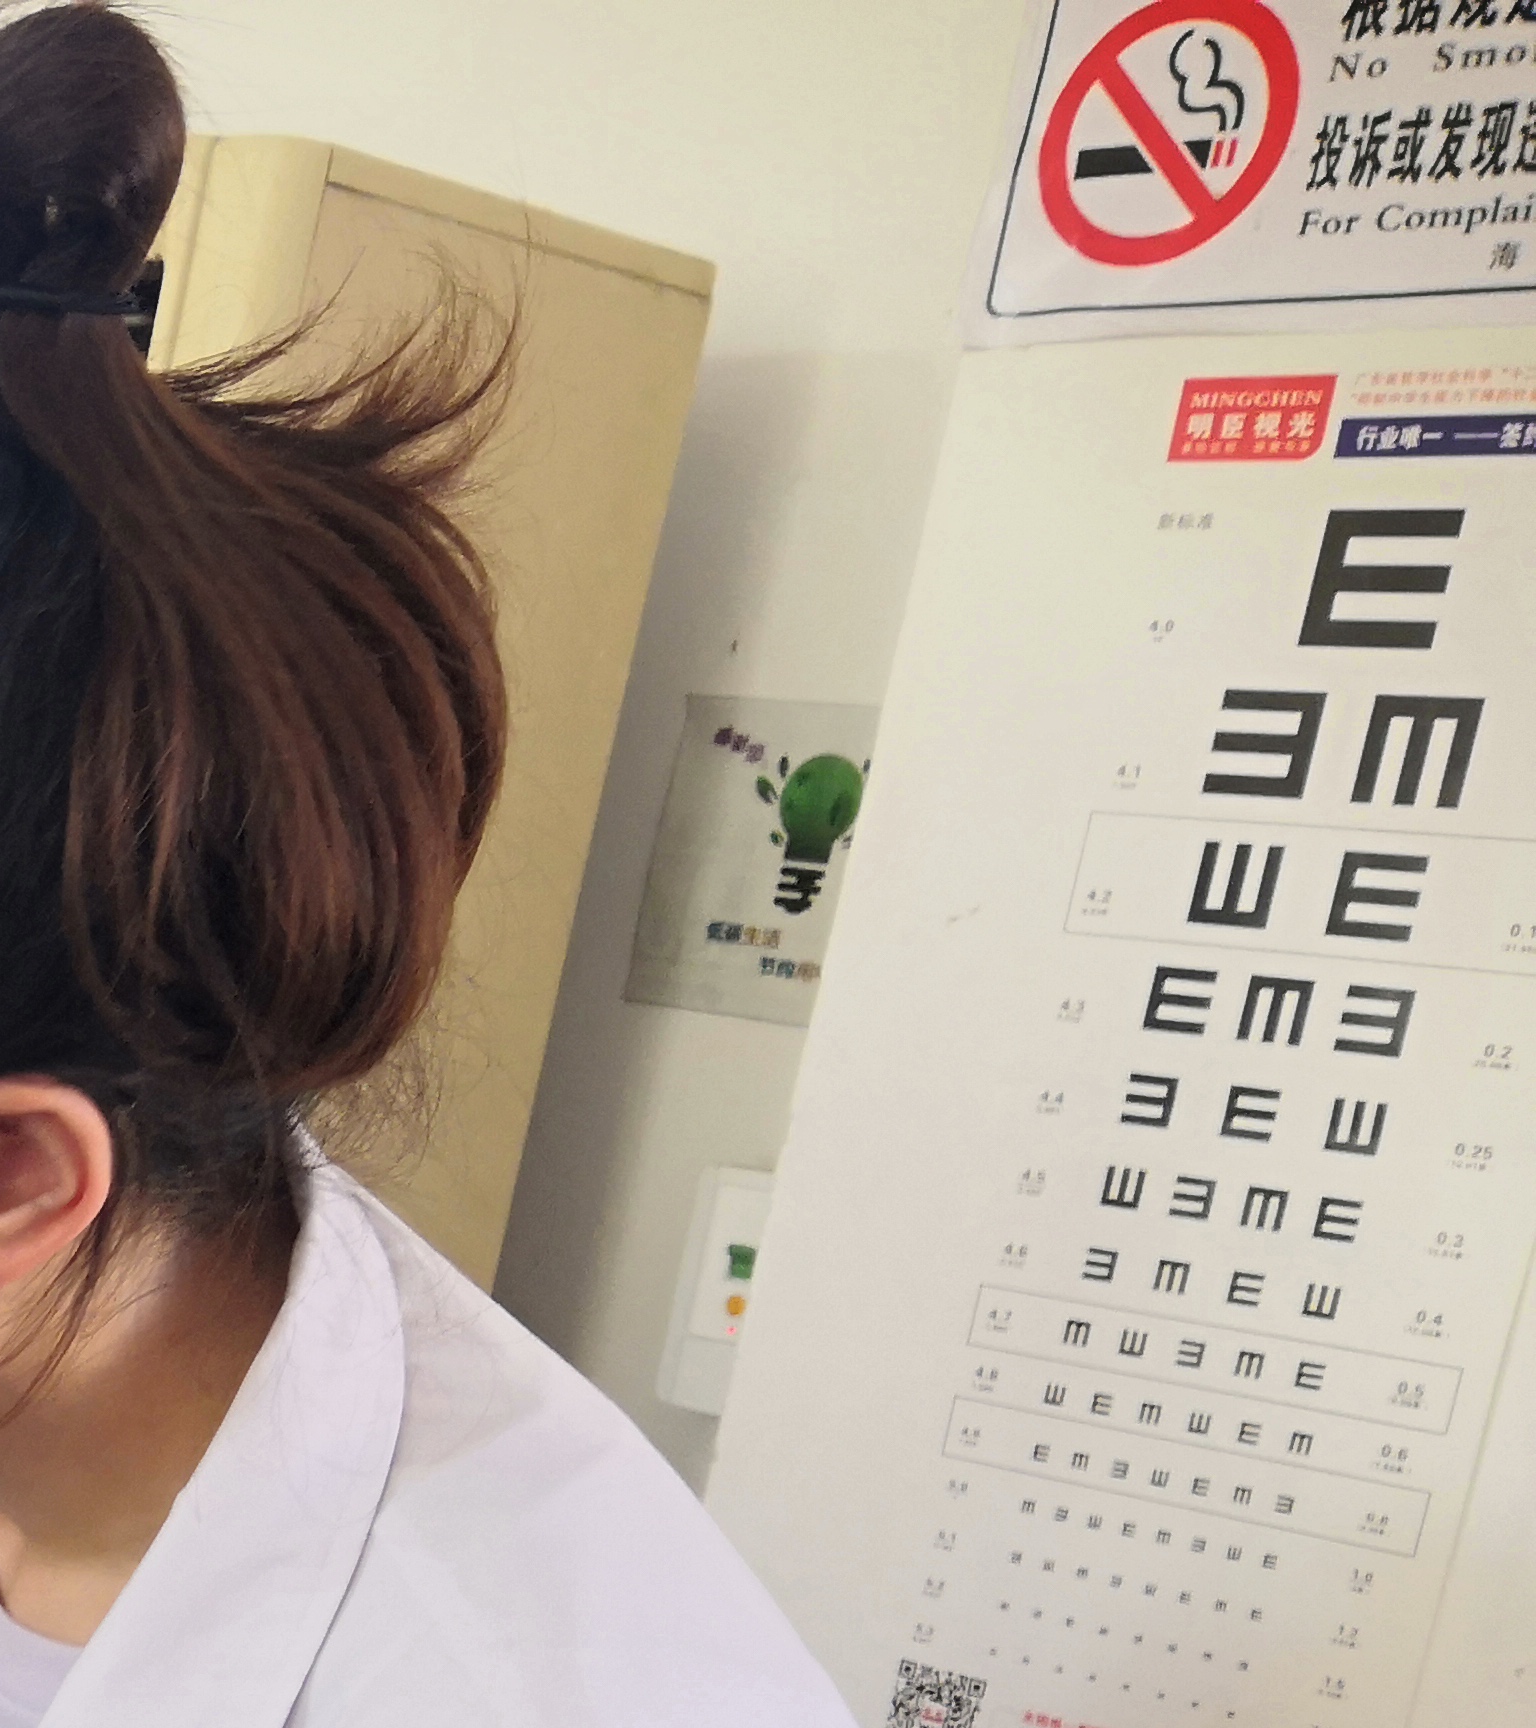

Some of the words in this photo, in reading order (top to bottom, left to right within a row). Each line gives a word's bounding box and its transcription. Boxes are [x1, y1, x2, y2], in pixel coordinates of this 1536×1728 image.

[1330, 53, 1387, 82] No
[1432, 42, 1536, 72] Smo
[1298, 209, 1361, 238] For
[1375, 192, 1536, 235] Complai
